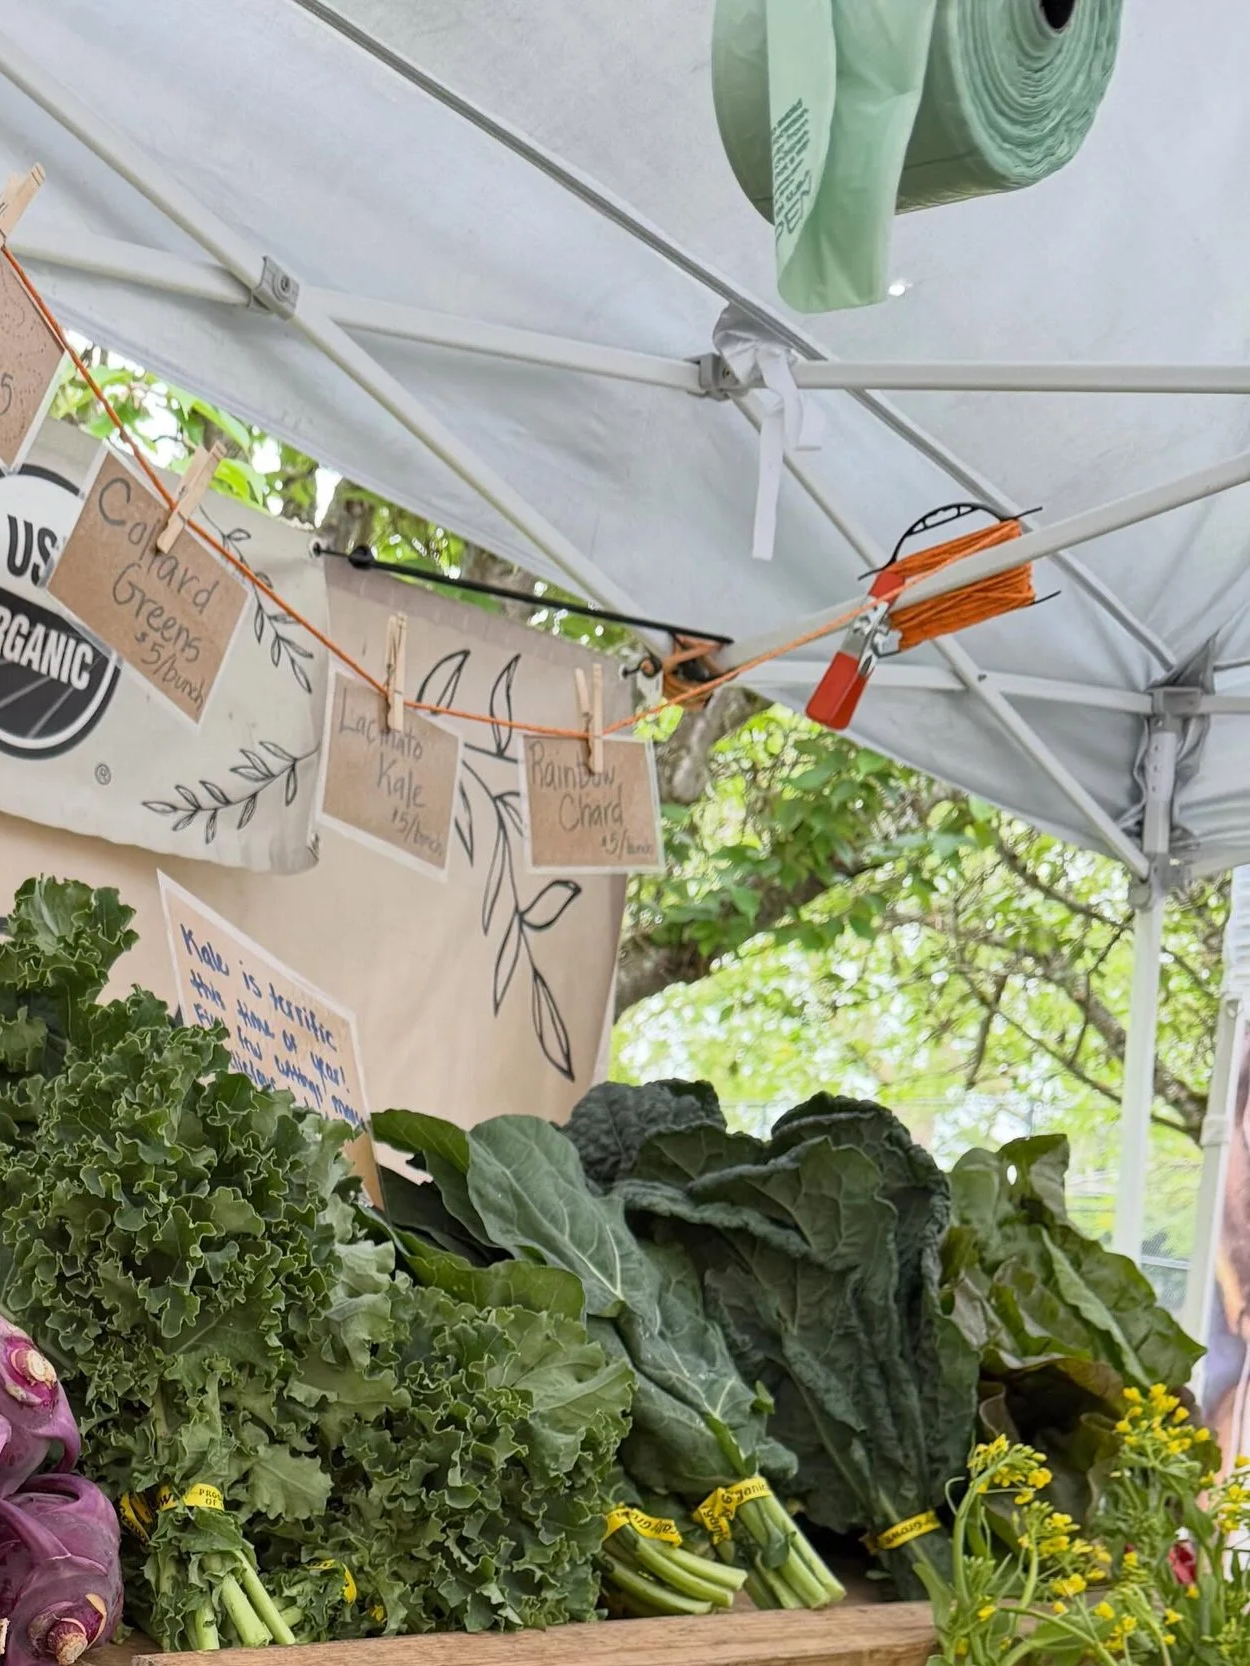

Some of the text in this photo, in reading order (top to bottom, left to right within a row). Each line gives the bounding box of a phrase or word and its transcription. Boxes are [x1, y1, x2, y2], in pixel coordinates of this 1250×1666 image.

[6, 513, 63, 588] US
[112, 562, 203, 663] Greens
[376, 751, 427, 809] Kale
[558, 782, 624, 834] Chard
[179, 923, 230, 977] Kale
[238, 959, 263, 999] is
[268, 982, 338, 1054] terrific
[189, 968, 227, 1012] this
